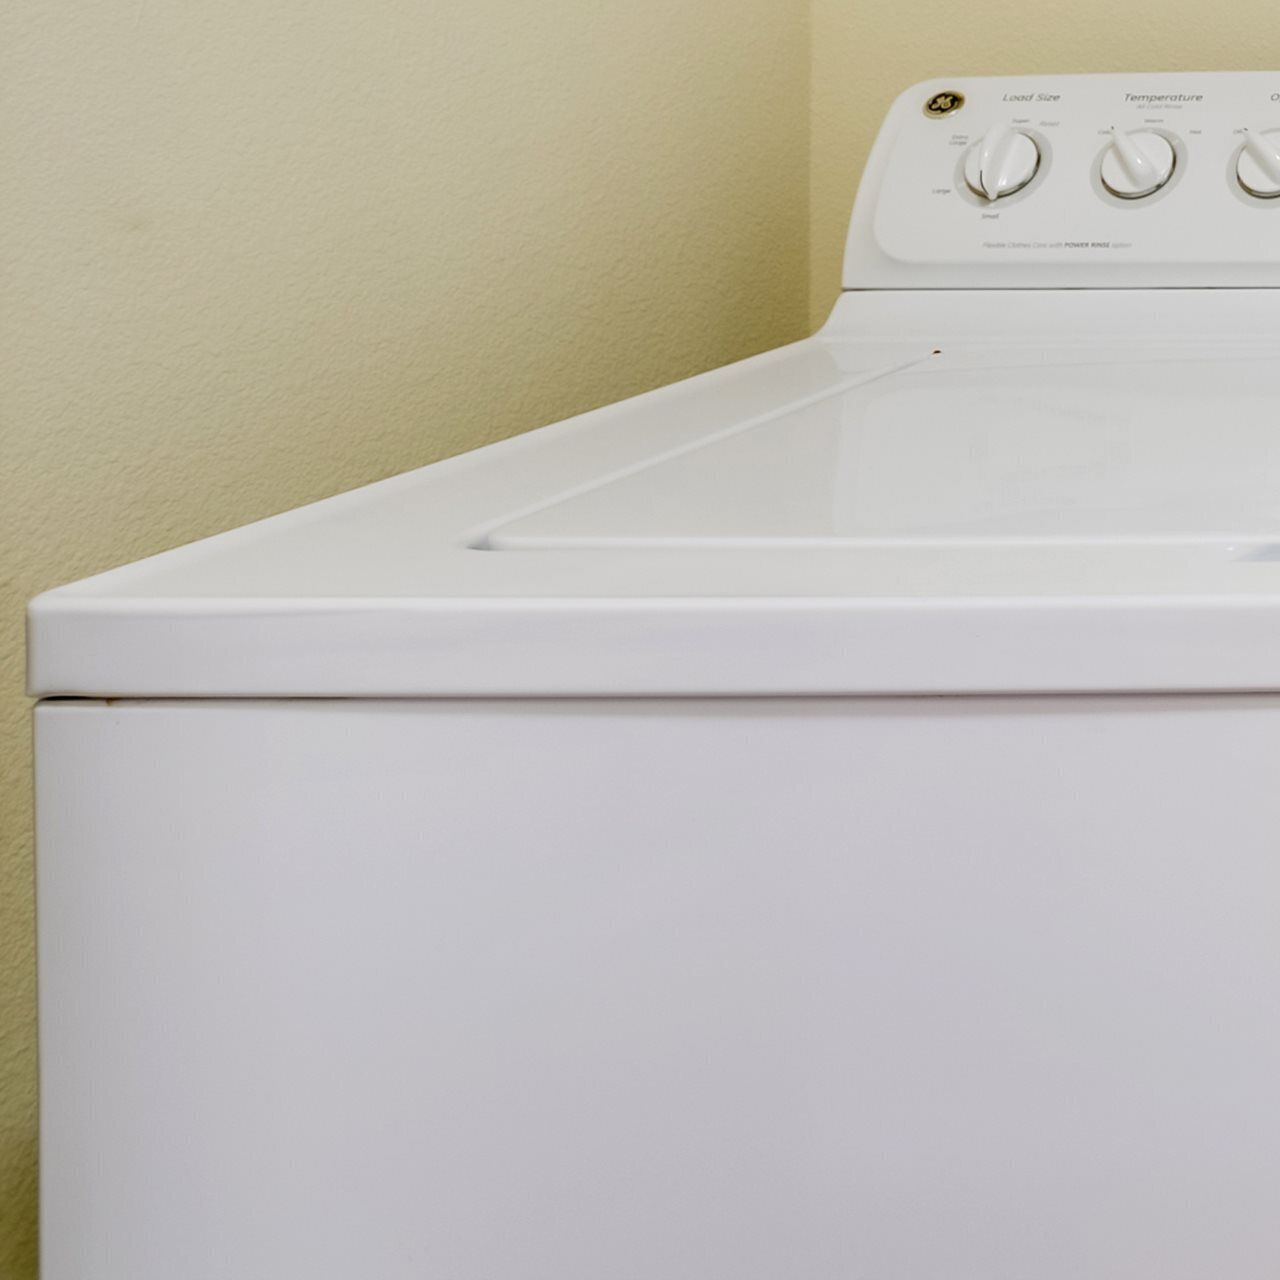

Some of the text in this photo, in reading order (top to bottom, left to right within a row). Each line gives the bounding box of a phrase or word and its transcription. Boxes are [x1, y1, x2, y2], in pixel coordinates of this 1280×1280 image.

[1003, 94, 1061, 102] Load Size
[1125, 93, 1203, 103] Temperature
